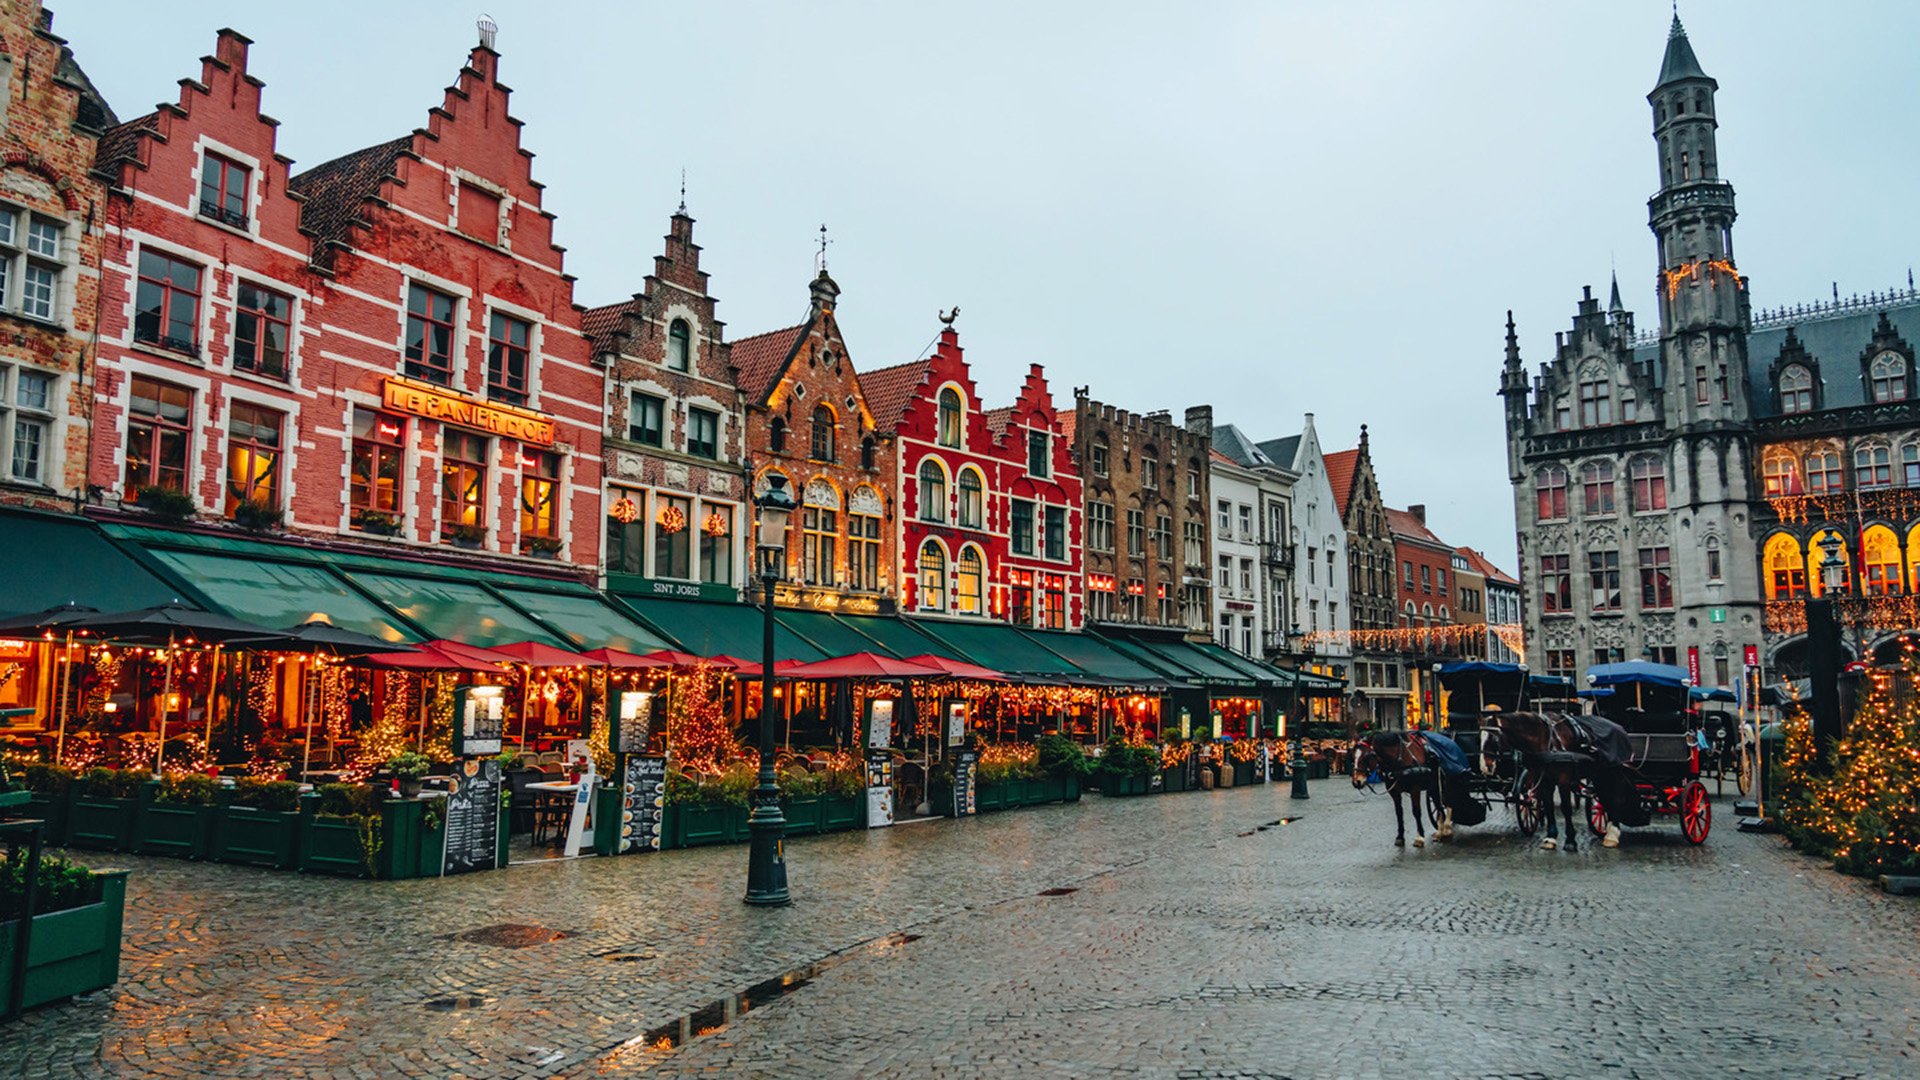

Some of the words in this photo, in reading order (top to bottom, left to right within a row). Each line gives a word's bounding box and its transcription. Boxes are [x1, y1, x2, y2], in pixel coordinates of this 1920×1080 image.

[392, 390, 425, 411] LE
[426, 397, 500, 431] PANIER
[507, 418, 550, 443] D'OR
[653, 583, 674, 594] SINT
[676, 585, 700, 596] JORIS
